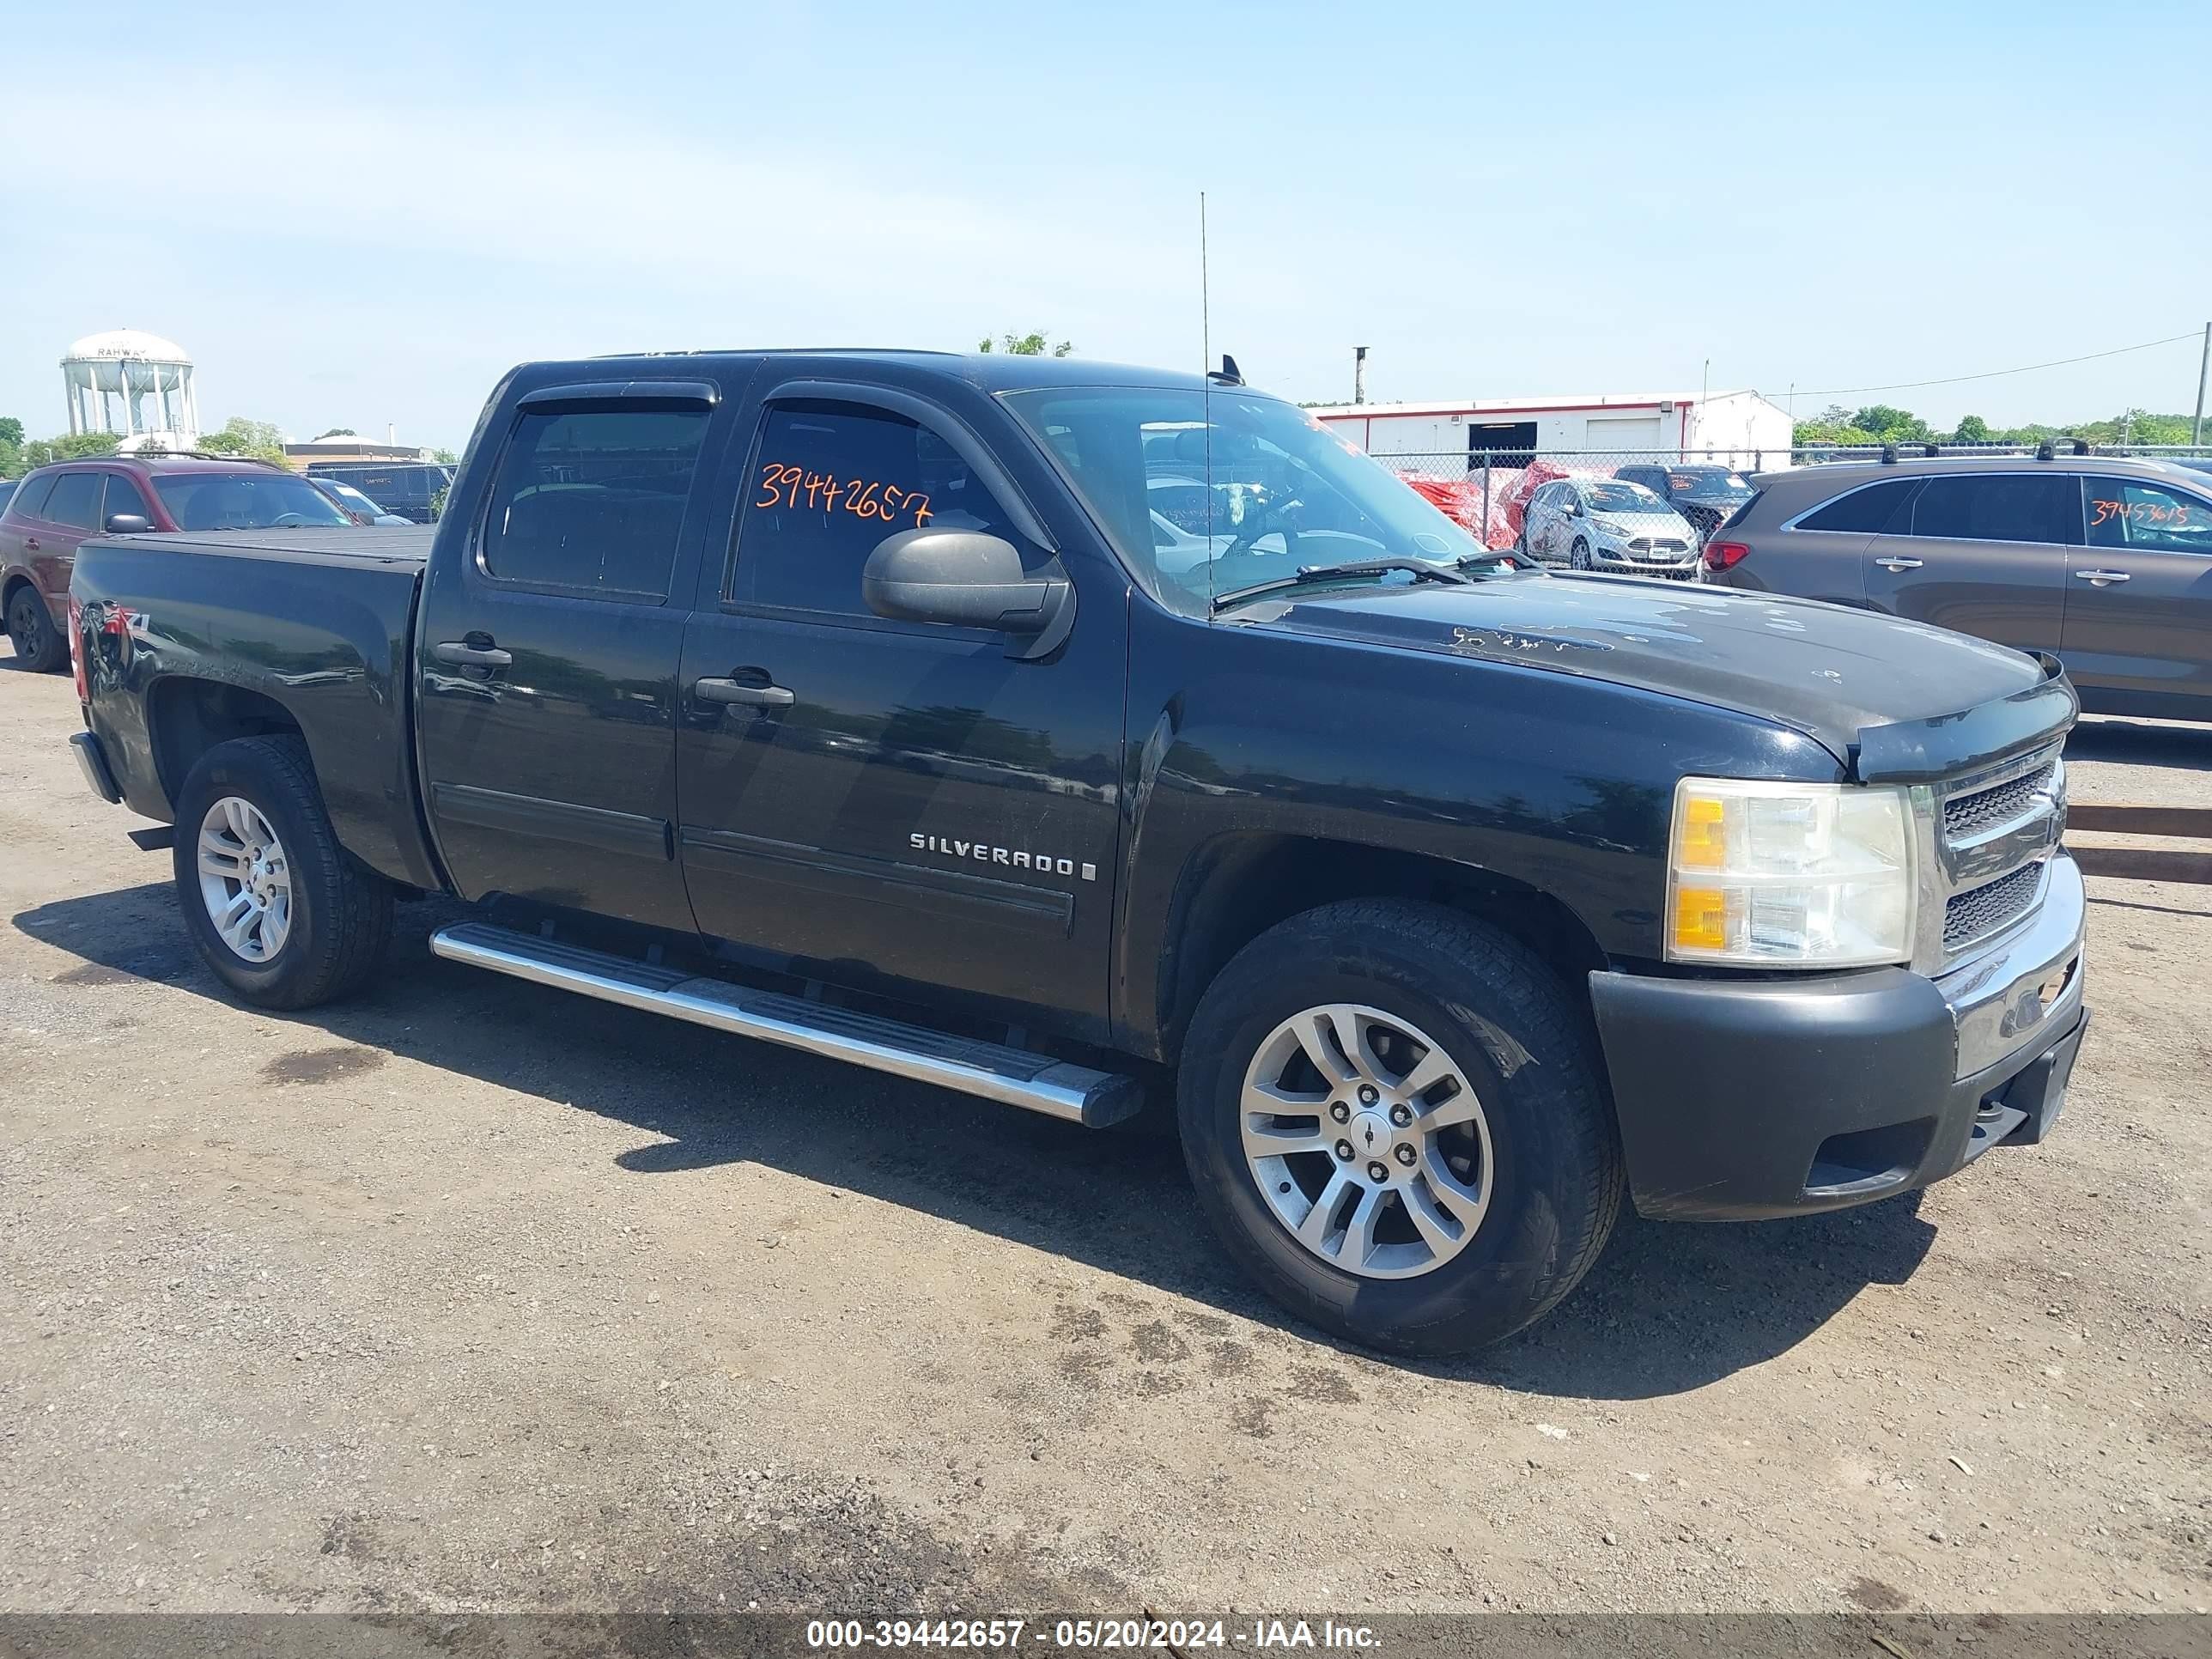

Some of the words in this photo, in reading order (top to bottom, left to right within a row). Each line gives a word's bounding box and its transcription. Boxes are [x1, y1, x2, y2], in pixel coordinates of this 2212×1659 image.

[97, 348, 146, 357] RAHWAY
[757, 464, 933, 529] 39442657
[2090, 501, 2190, 526] 39453615
[910, 833, 1073, 876] SILVERADO
